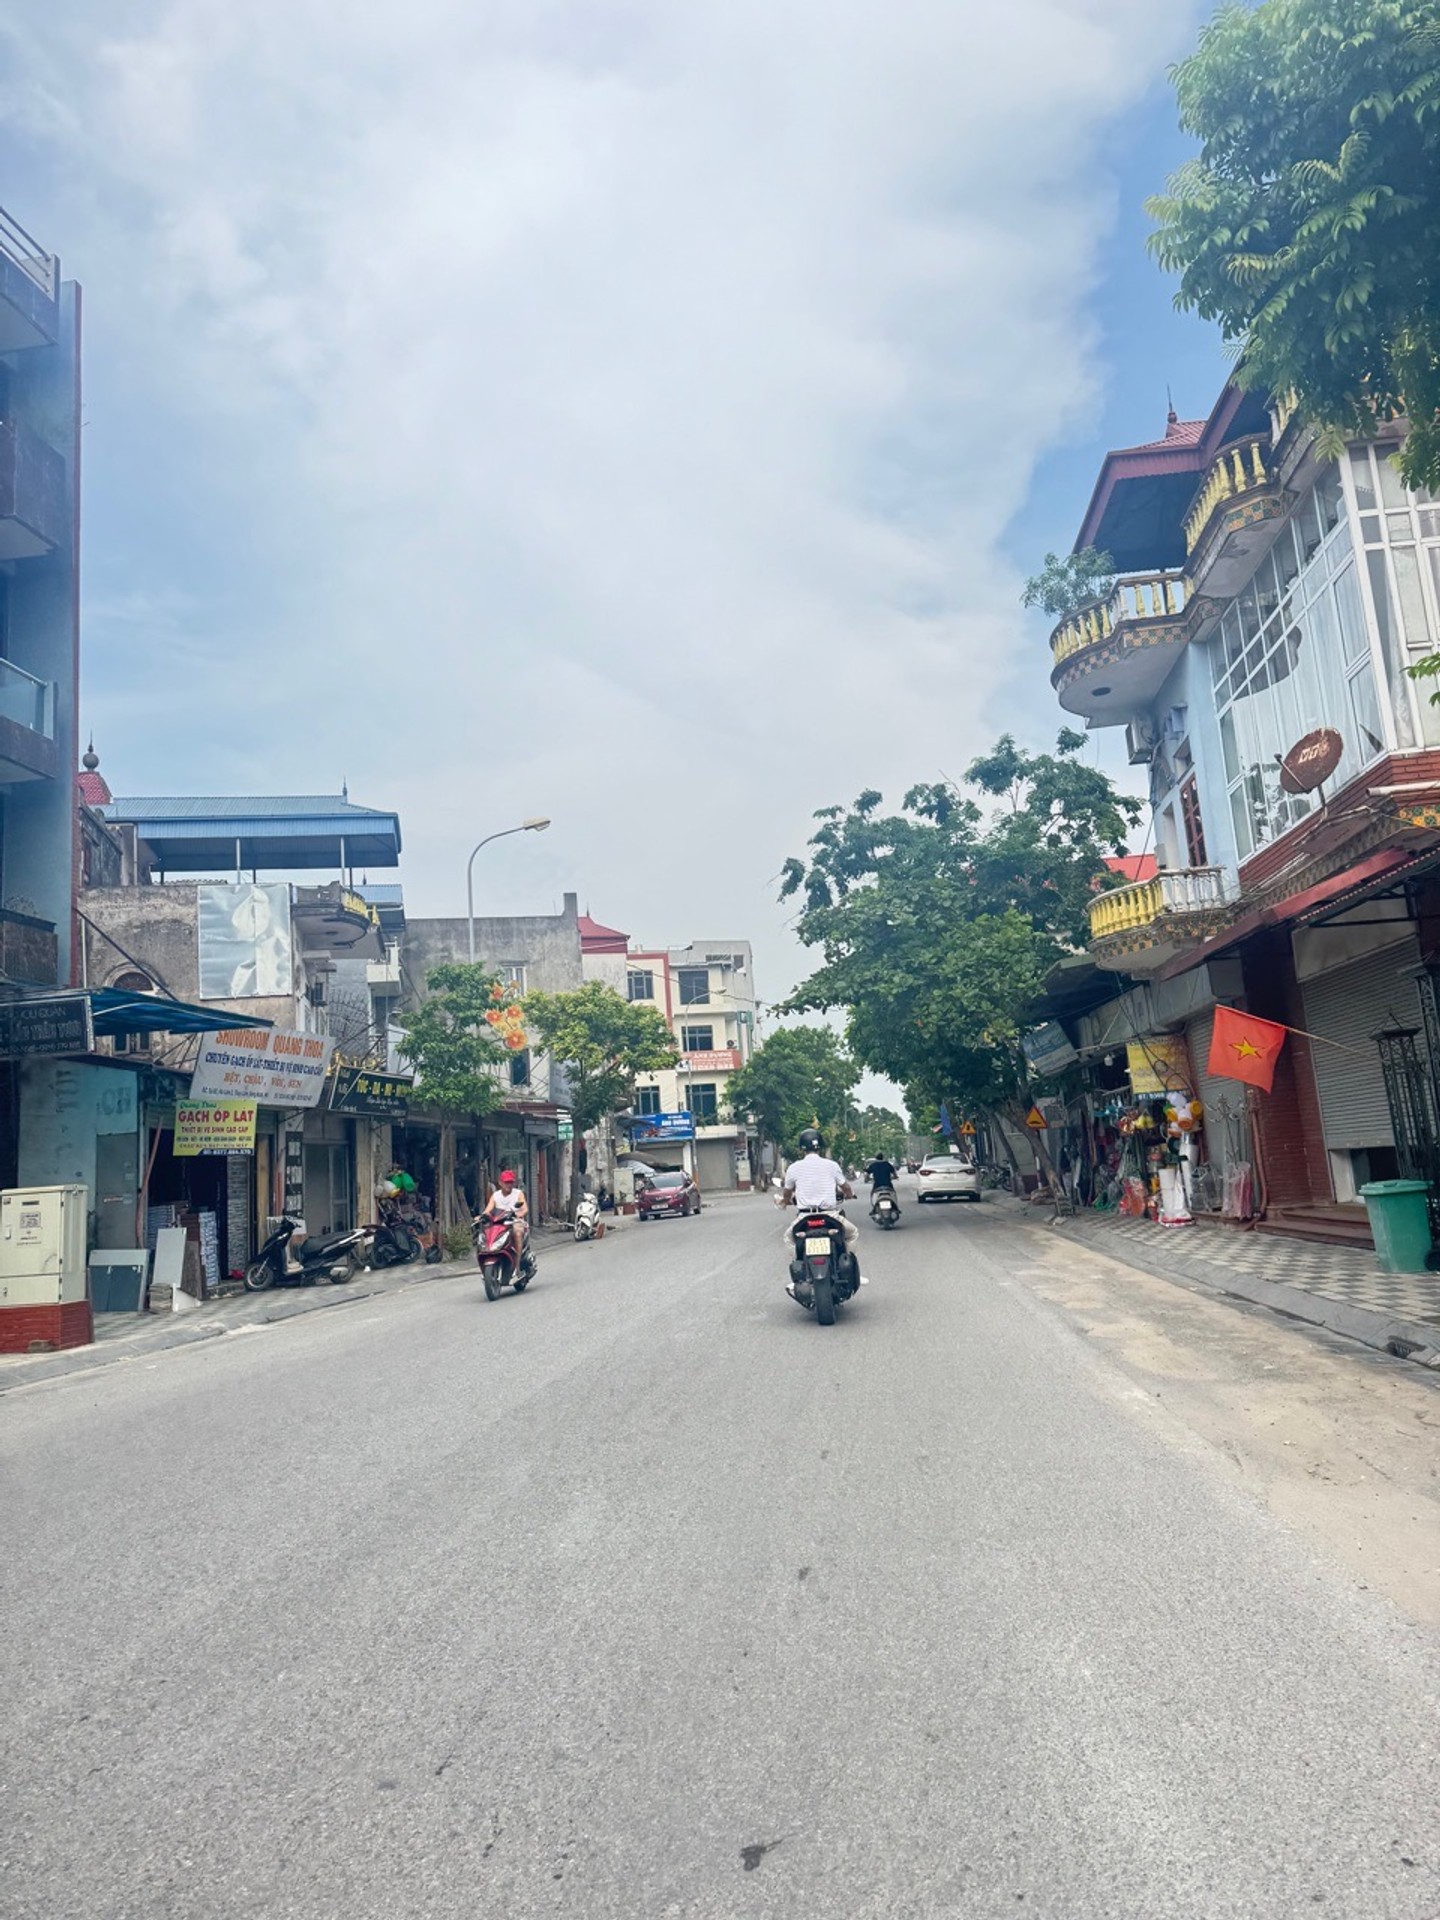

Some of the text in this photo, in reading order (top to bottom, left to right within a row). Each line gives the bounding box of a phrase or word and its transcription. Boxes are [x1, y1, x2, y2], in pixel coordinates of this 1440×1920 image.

[216, 1030, 324, 1058] SHOWROOM QUANG THOA
[178, 1106, 254, 1126] GẠCH ỐP LÁT
